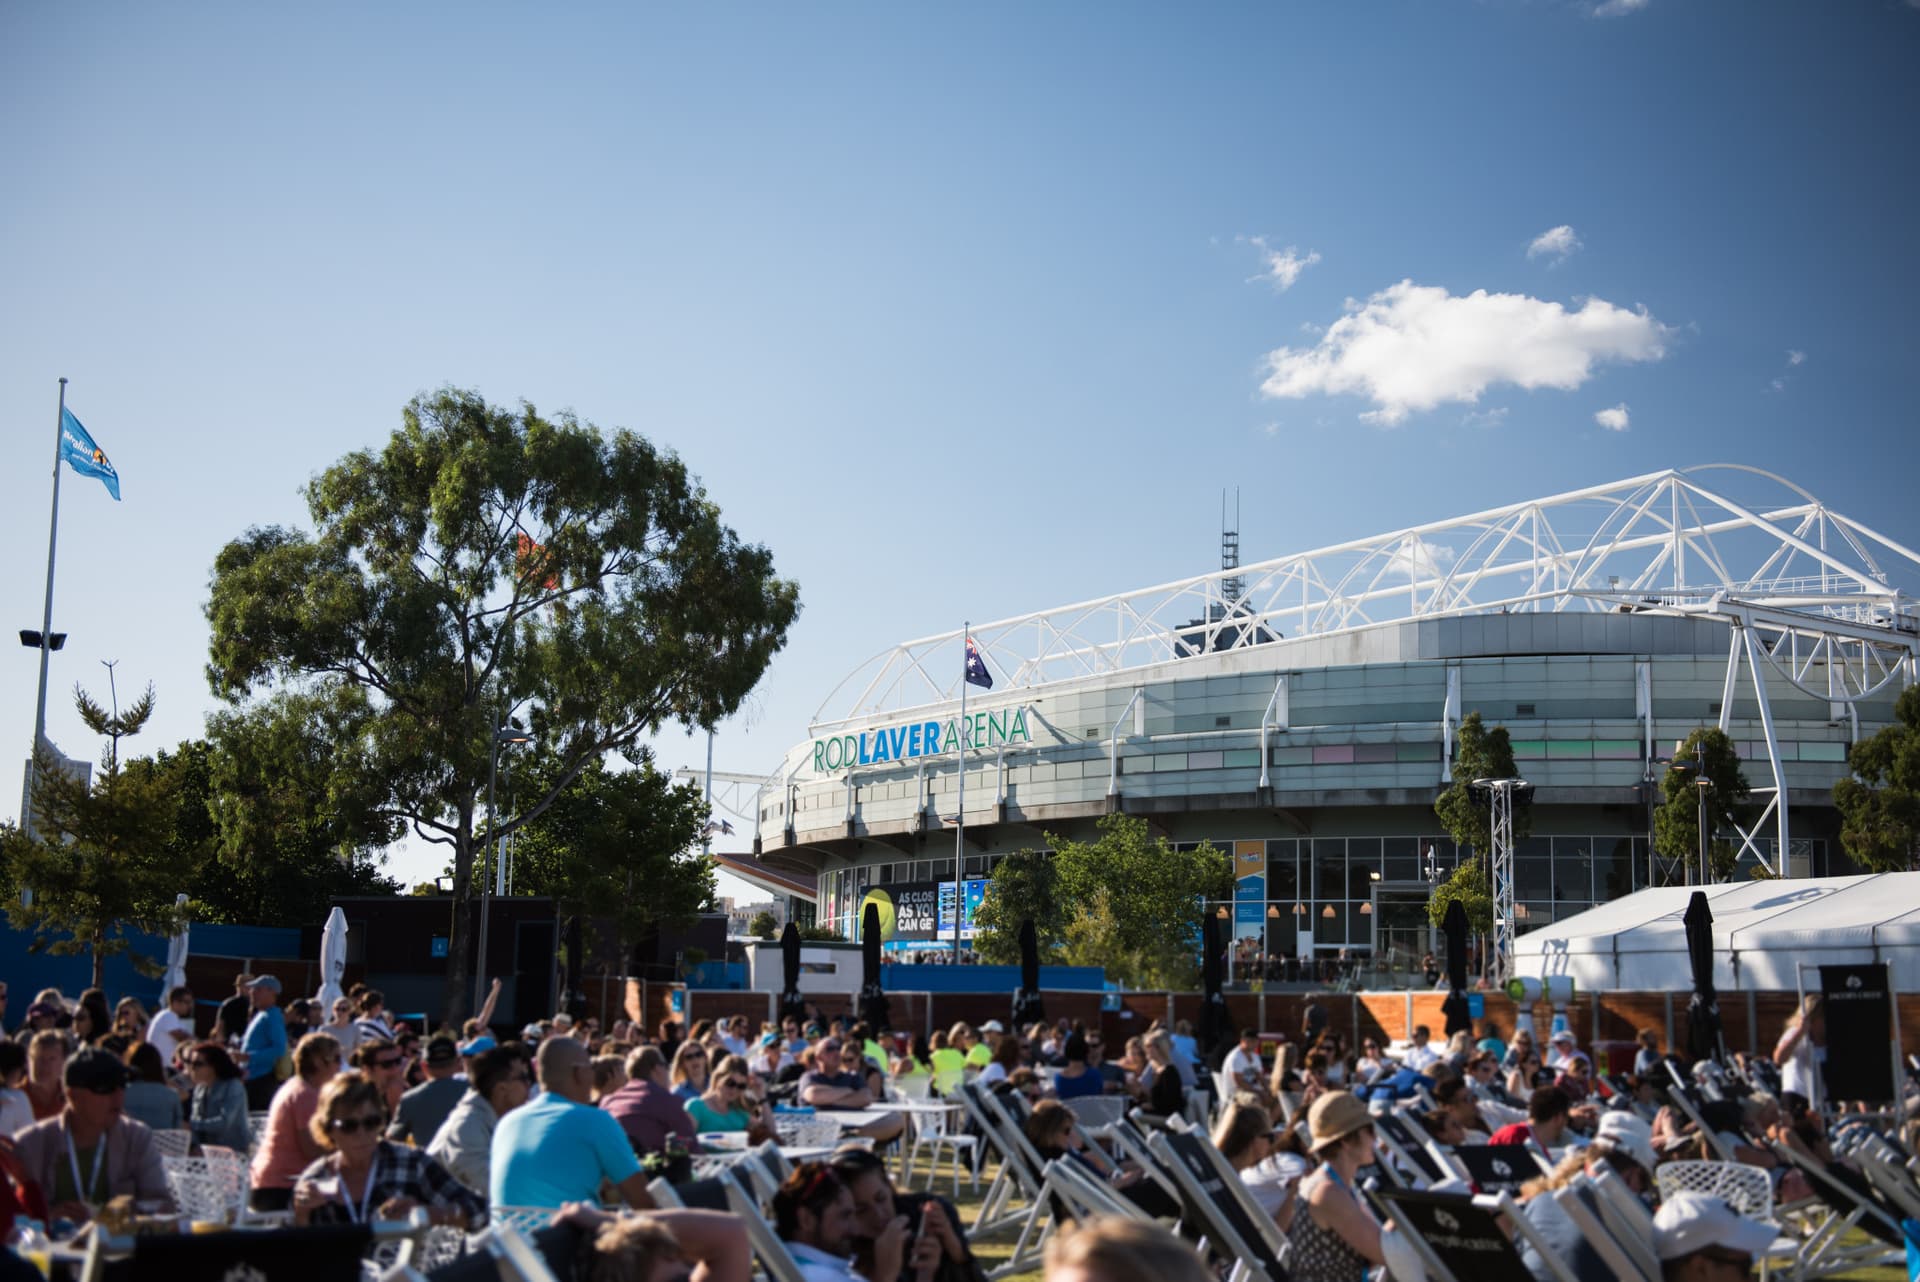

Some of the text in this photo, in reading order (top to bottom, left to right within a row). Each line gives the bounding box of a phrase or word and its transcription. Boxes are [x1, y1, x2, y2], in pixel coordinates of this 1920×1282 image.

[814, 707, 1029, 772] ROD LAVER ARENA
[898, 891, 934, 904] AS CLOS
[898, 904, 913, 919] AS
[898, 918, 918, 931] CAN
